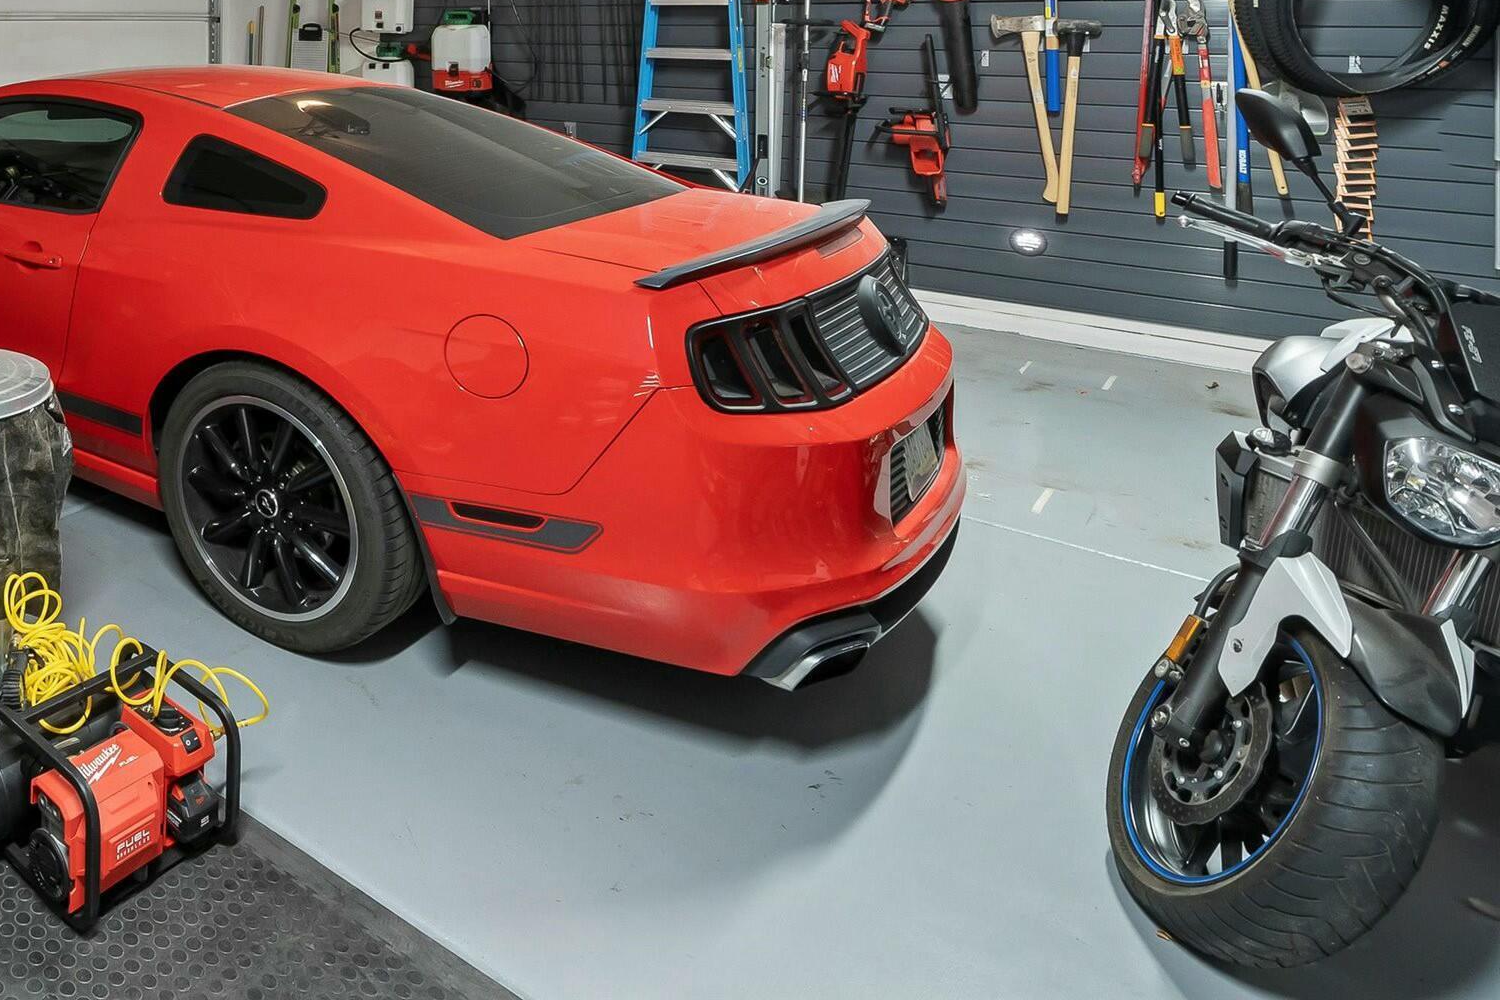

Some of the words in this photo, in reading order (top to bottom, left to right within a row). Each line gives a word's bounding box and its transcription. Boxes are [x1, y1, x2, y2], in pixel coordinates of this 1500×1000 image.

[1423, 4, 1450, 50] MAXXIS
[1238, 149, 1248, 175] KOBALT
[116, 829, 150, 854] FUEL
